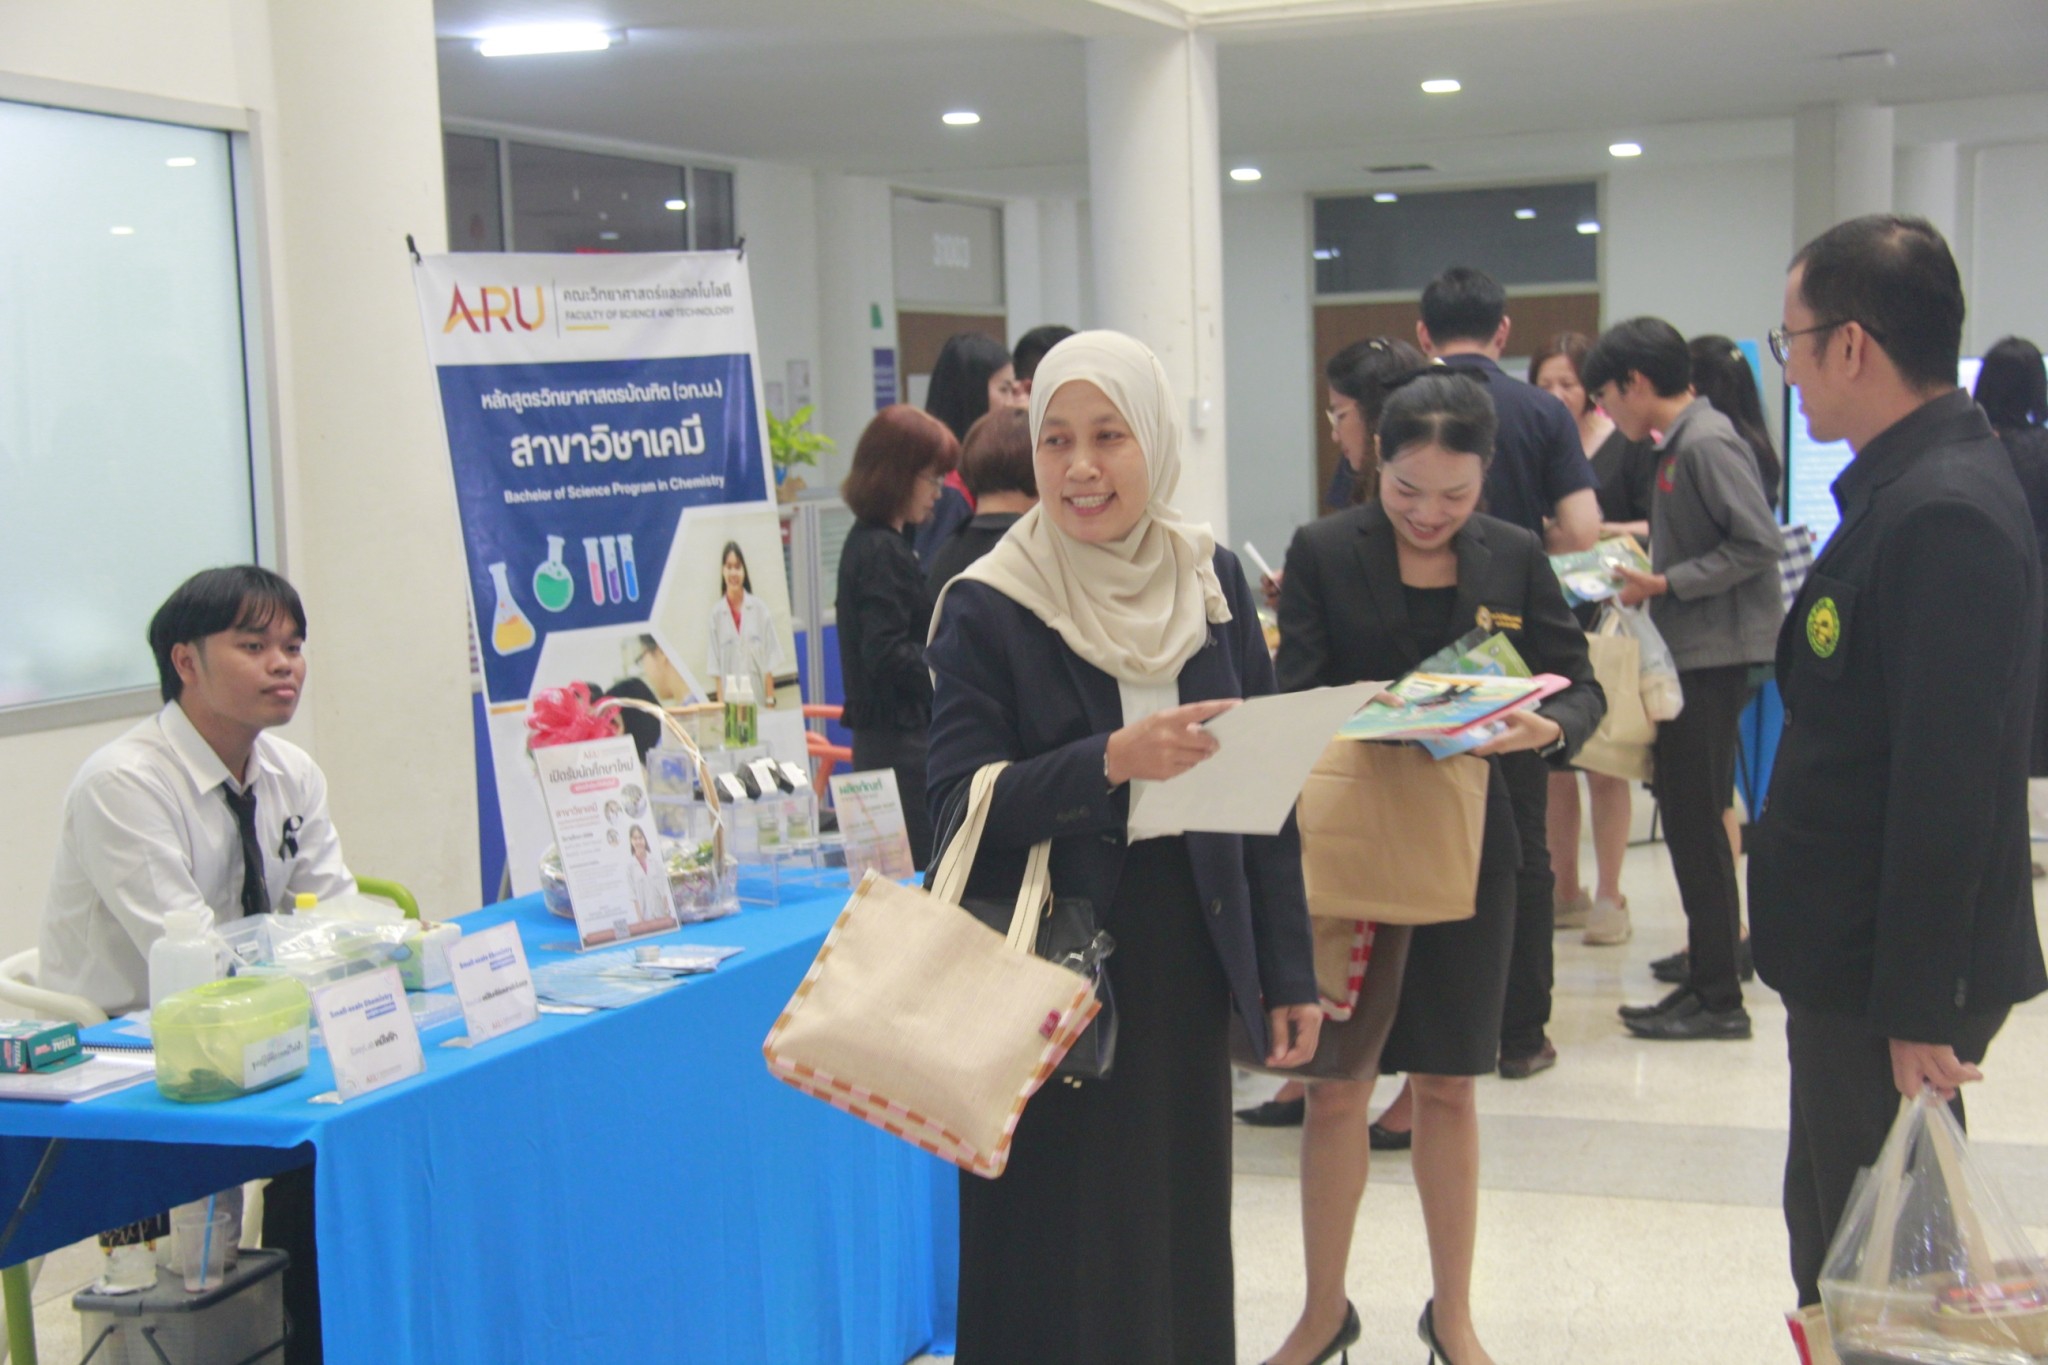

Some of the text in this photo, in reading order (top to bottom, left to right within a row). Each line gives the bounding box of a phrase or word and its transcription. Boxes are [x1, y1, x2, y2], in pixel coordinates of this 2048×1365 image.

[442, 281, 545, 333] ARU
[565, 305, 735, 321] FACULTY OF SCIENCE AND TECHNOLOGY
[510, 412, 706, 468] สาขาวิชาเคมี
[503, 474, 725, 504] Bachelor of Science Program in Chemistry
